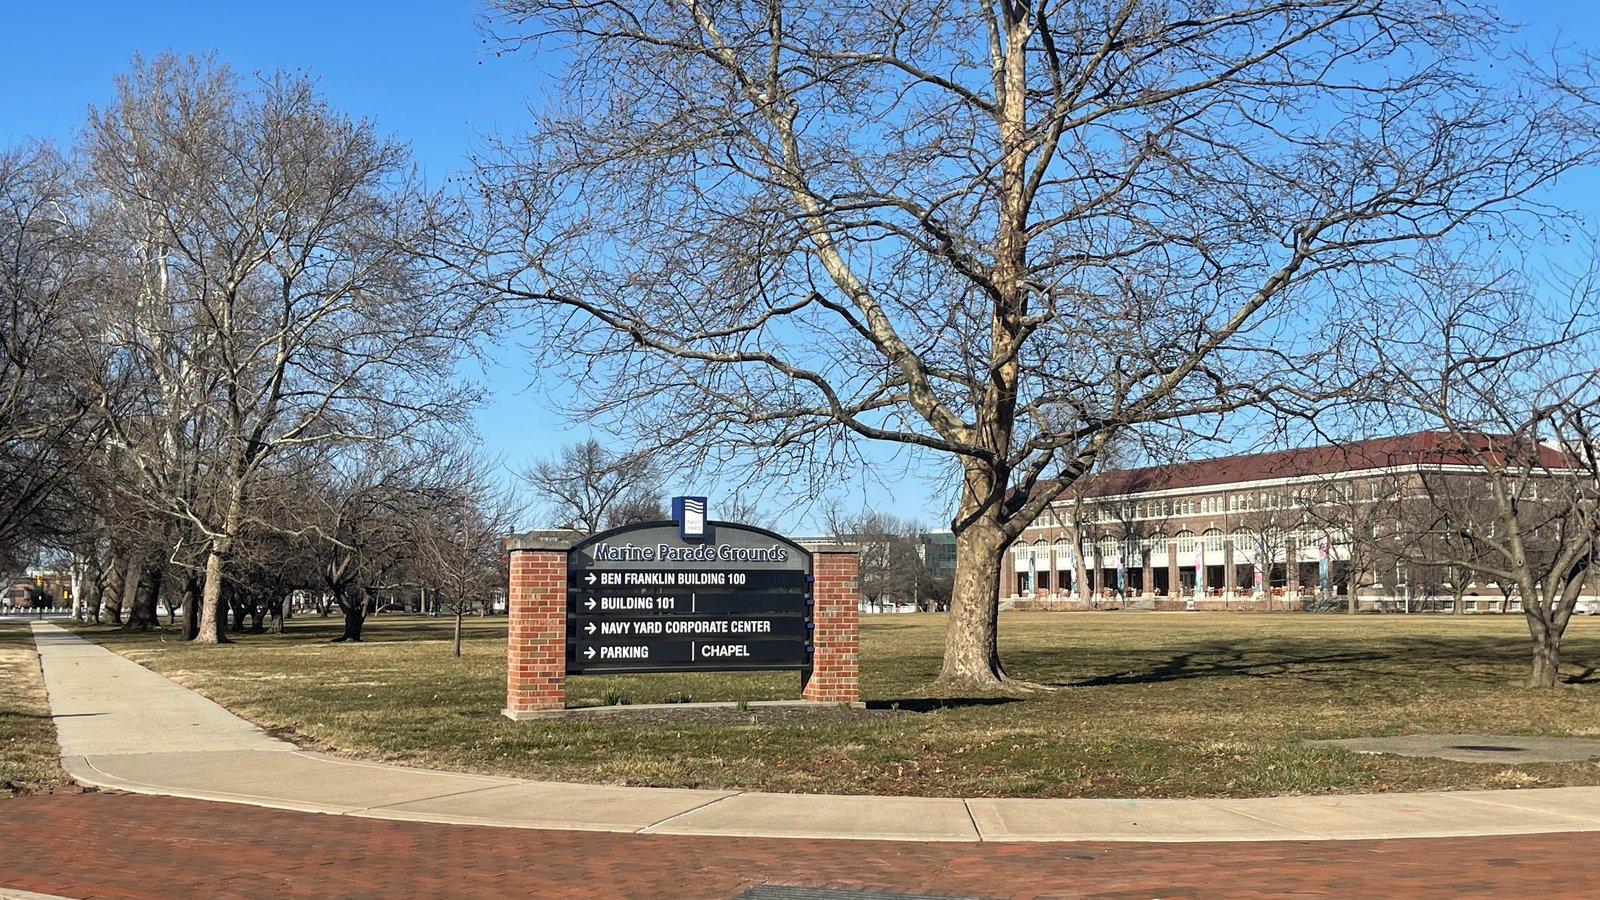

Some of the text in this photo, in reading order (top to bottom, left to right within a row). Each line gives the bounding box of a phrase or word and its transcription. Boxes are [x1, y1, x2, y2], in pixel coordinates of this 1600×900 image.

[593, 543, 788, 562] Marine Parade Grounds
[600, 574, 622, 584] BEN
[625, 574, 675, 584] FRANKLIN
[678, 574, 725, 584] BUILDING
[728, 574, 746, 584] 100
[600, 597, 674, 610] BUILDING 101
[600, 620, 770, 634] NAVY YARD CORPORATE CENTER
[600, 646, 648, 658] PARKING
[702, 644, 750, 656] CHAPEL
